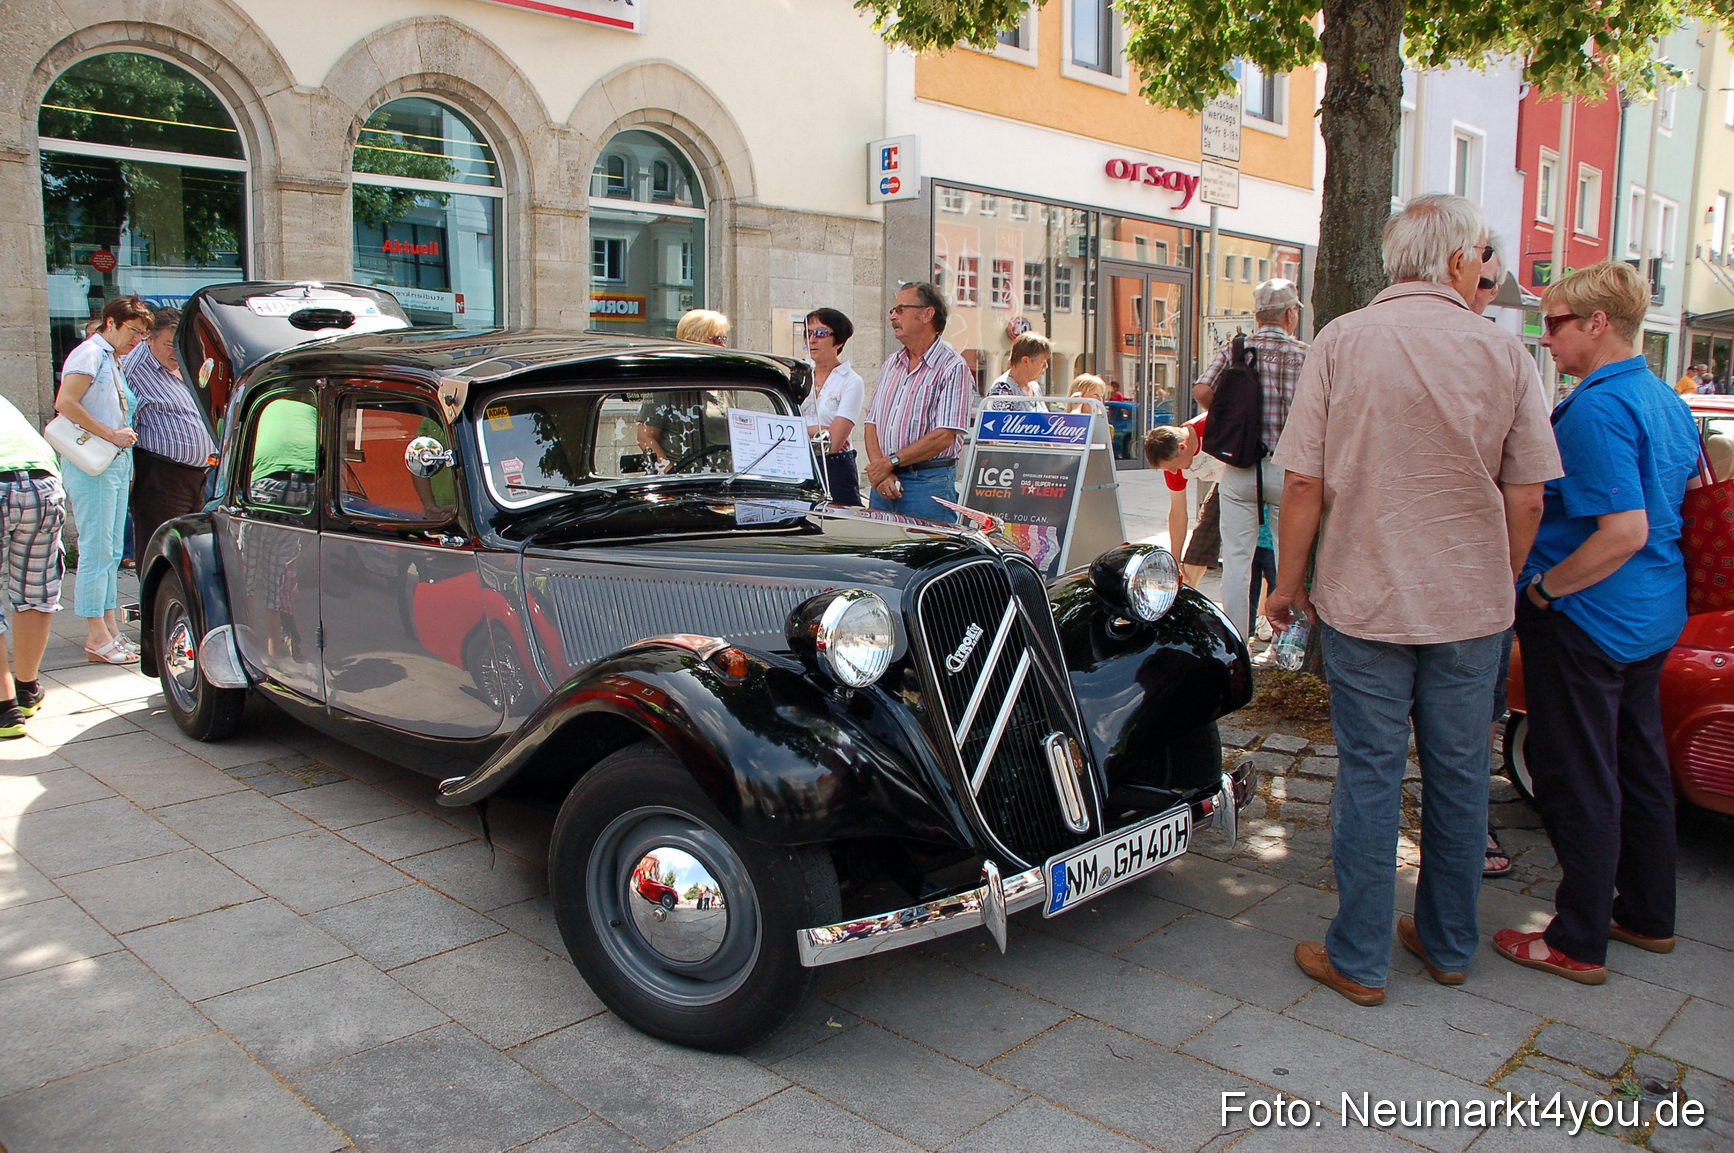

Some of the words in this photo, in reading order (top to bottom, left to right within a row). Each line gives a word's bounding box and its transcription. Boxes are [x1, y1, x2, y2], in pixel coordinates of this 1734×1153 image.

[1205, 97, 1239, 112] arkschein
[1208, 110, 1236, 126] werktags
[1204, 124, 1221, 136] Mo-Fr
[1204, 137, 1211, 148] Sa
[1105, 158, 1199, 210] orsay
[382, 239, 439, 256] Aktuell
[488, 407, 508, 417] ADAC
[767, 423, 798, 443] 122
[1000, 414, 1041, 435] Uhren
[1041, 415, 1087, 443] Stang
[978, 466, 1015, 487] ice
[975, 488, 1012, 499] watch
[1013, 514, 1028, 522] YOU
[1030, 515, 1049, 524] CAN.
[1056, 892, 1063, 903] D
[1066, 854, 1098, 901] NM
